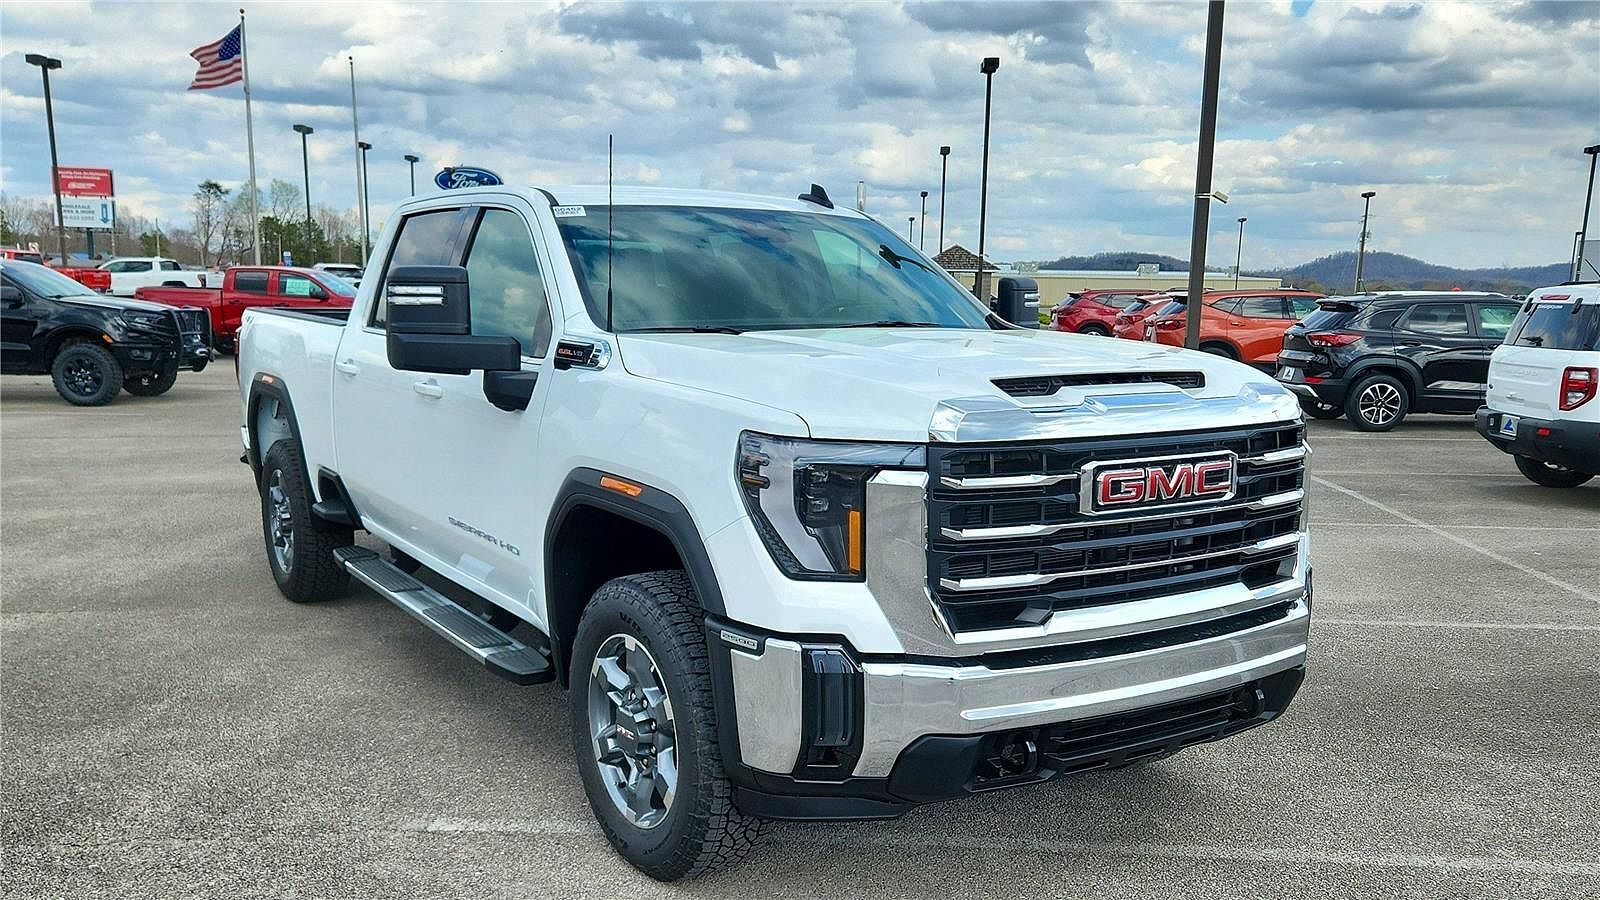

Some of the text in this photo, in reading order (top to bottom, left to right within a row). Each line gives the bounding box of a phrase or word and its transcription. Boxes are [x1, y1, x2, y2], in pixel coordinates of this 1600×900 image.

[1097, 461, 1203, 506] GMC
[448, 515, 521, 557] SIERRA HD
[721, 631, 758, 650] 2500
